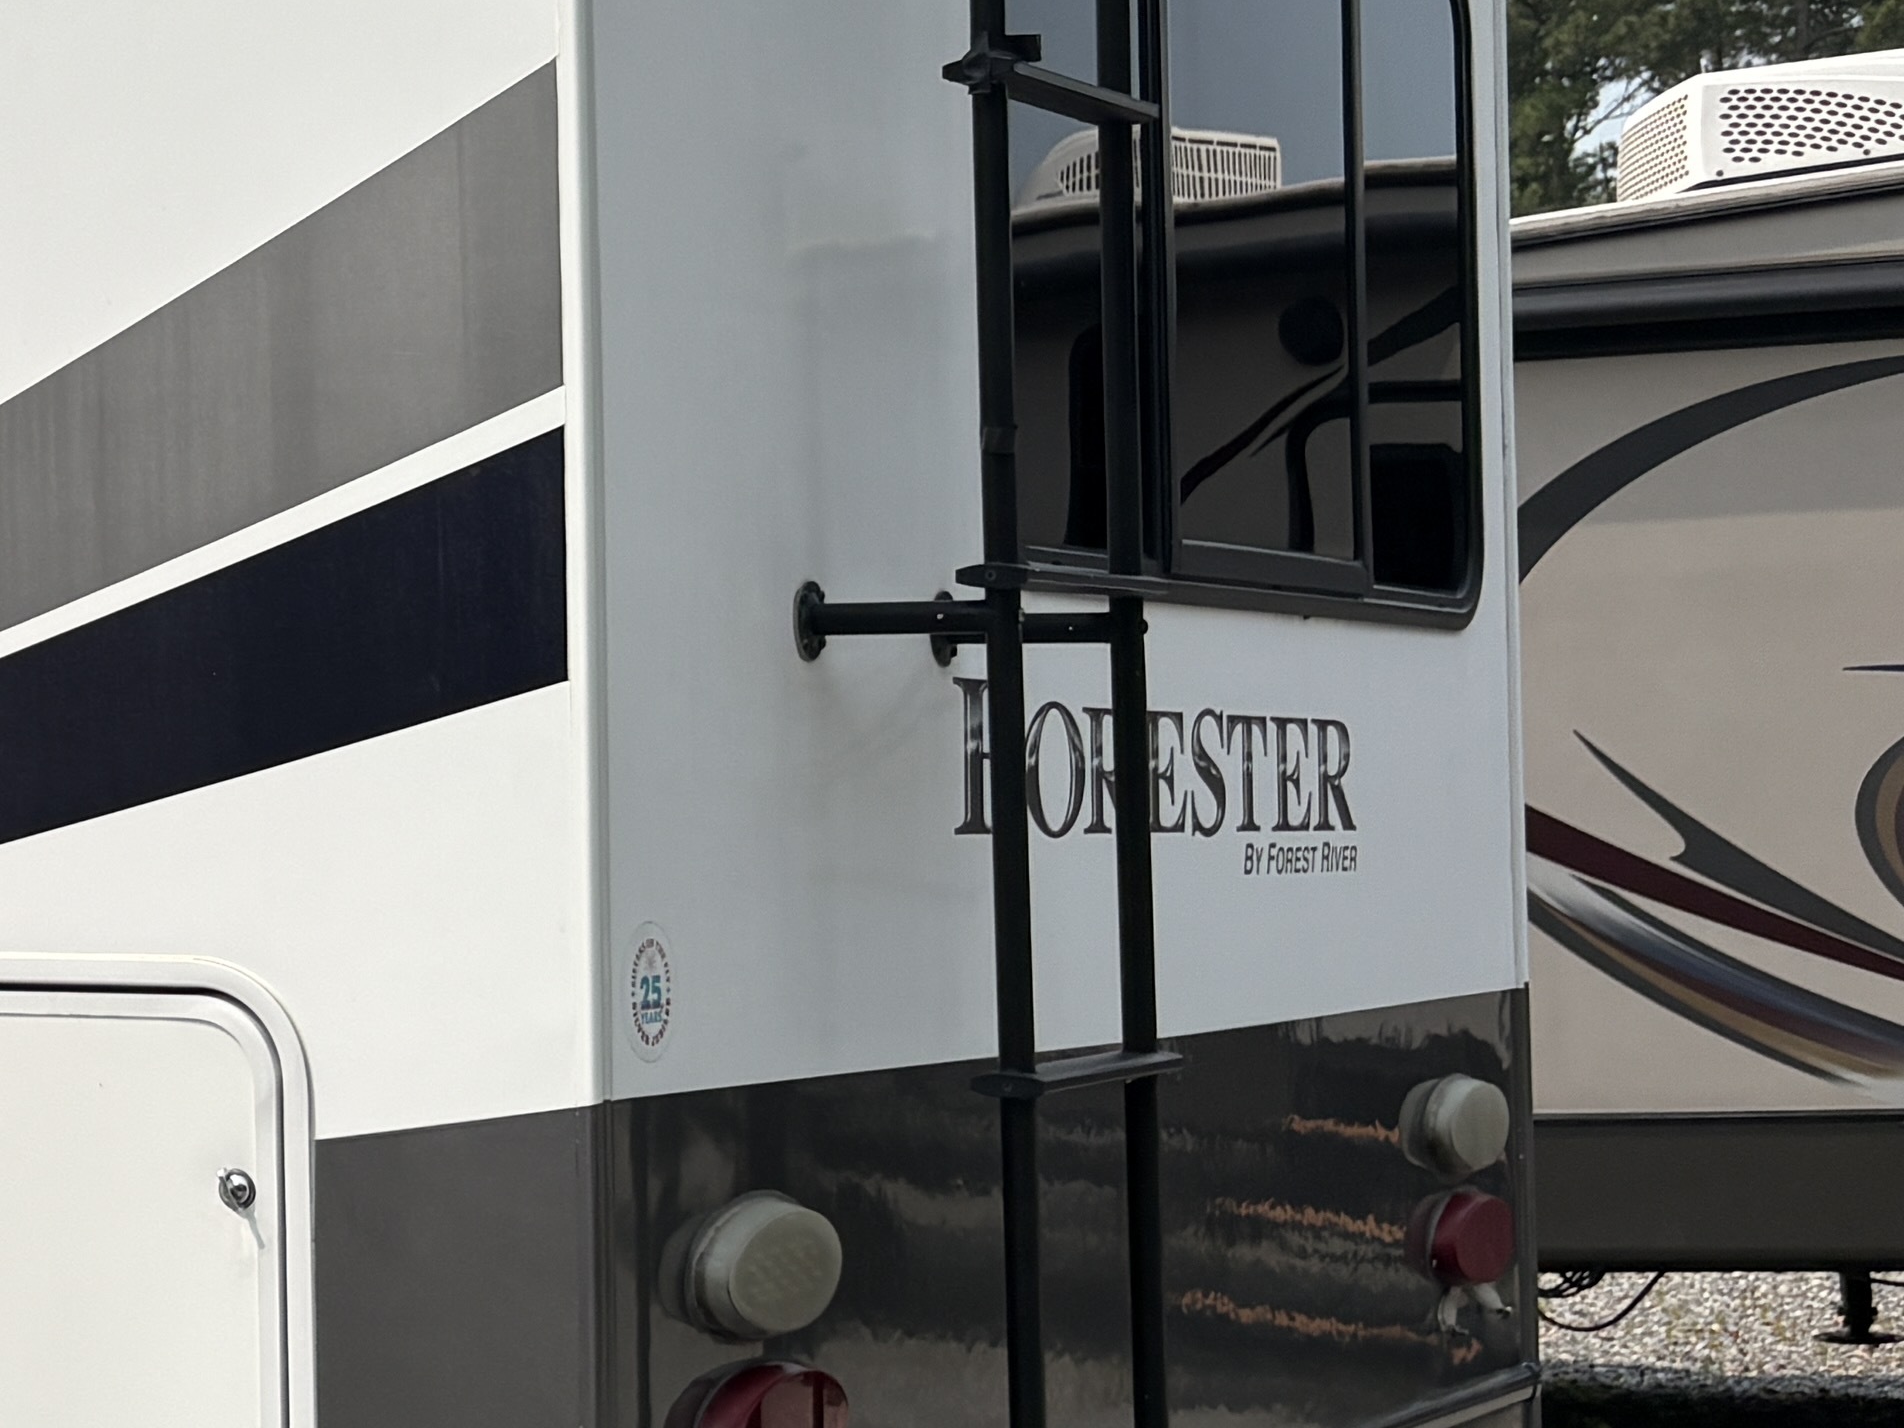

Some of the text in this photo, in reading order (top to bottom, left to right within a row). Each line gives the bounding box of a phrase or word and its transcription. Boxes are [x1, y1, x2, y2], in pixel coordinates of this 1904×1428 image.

[1243, 841, 1358, 876] BY FOREST RIVER
[640, 974, 662, 1010] 25
[641, 1009, 663, 1025] YEARS
